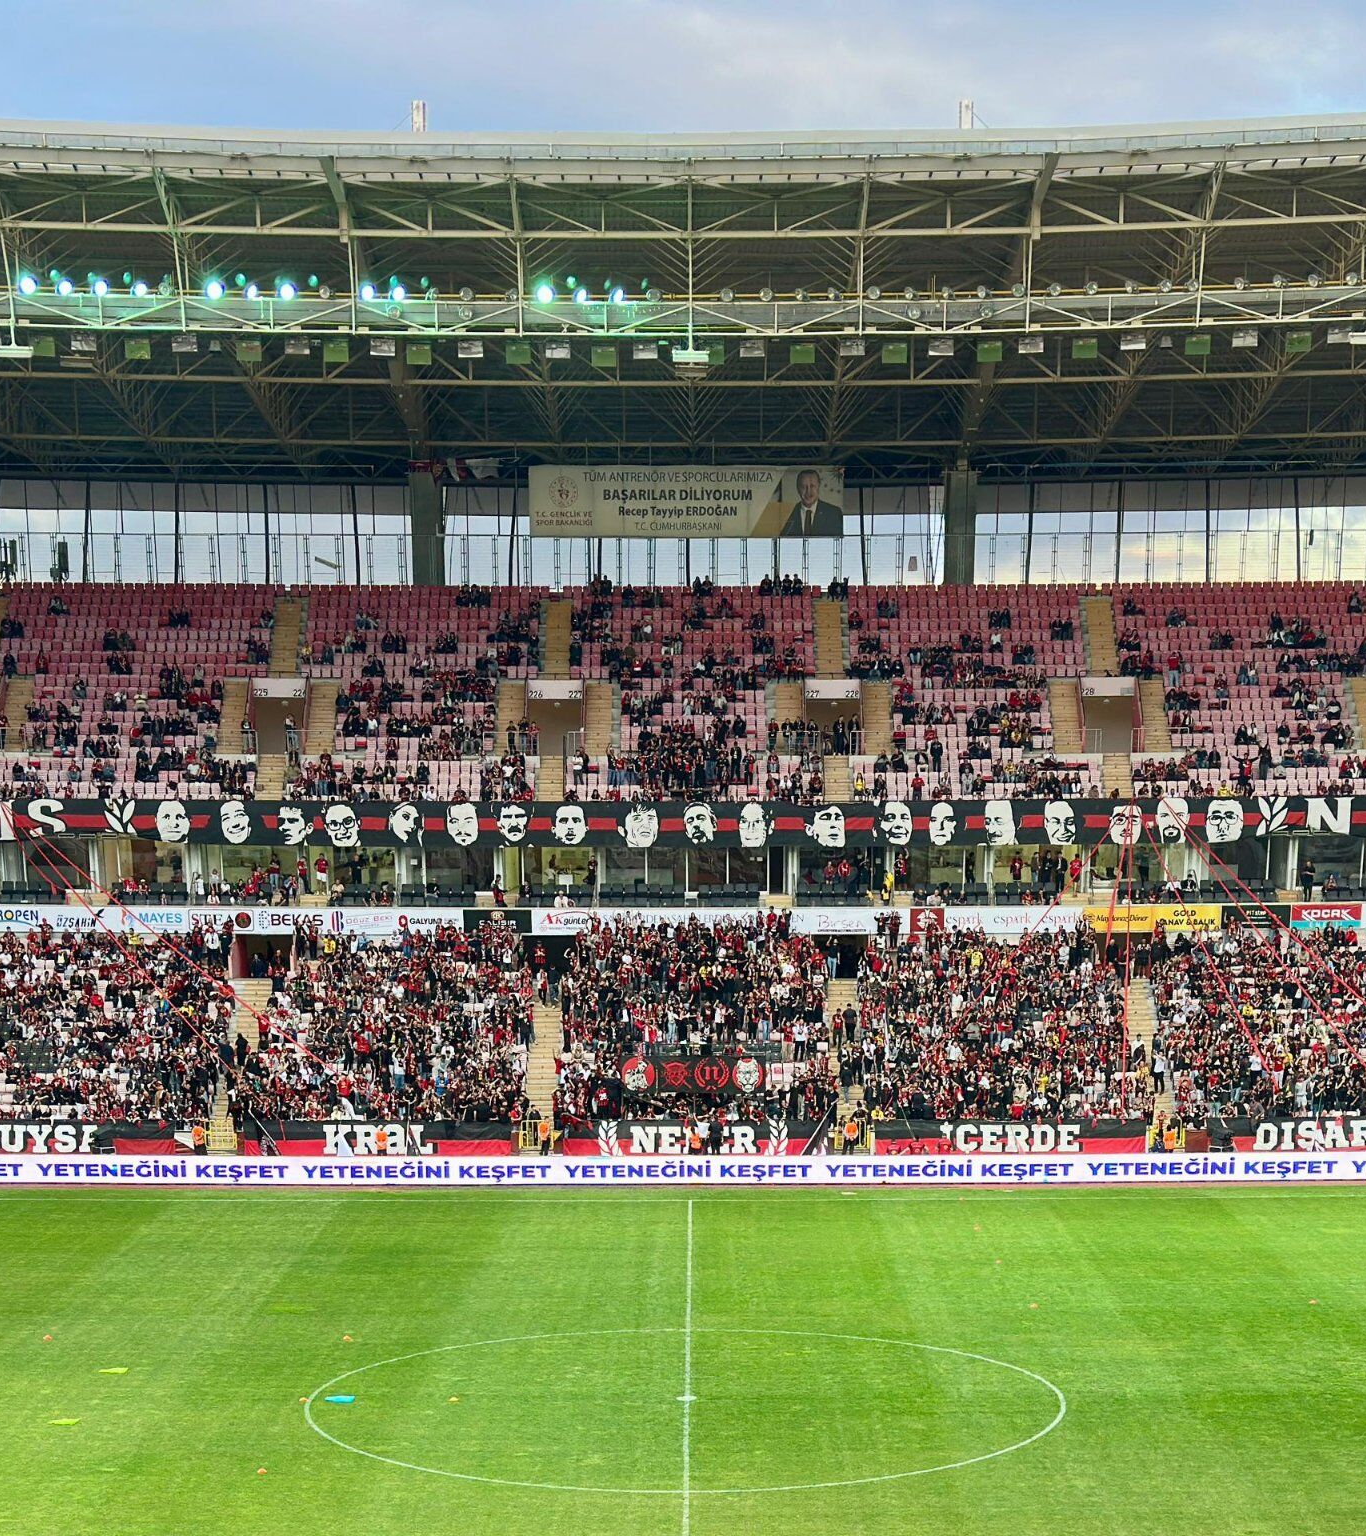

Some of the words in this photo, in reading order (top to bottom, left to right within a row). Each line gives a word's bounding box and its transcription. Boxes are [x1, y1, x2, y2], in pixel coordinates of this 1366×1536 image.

[584, 470, 607, 482] TÜM
[609, 470, 667, 482] ANTRENÖR
[668, 472, 680, 482] VE
[681, 472, 773, 483] SPORCULARIMIZA
[603, 489, 676, 502] BAŞARILAR
[679, 487, 753, 501] DİLİYORUM
[618, 506, 647, 519] Recep
[650, 505, 683, 519] Tayyip
[686, 504, 738, 517] ERDOĞAN
[650, 522, 722, 533] CUMHURBAŞKANI
[139, 912, 183, 924] MAYES
[1174, 910, 1197, 918] GOLD
[1193, 918, 1216, 926] BALIK
[37, 1160, 187, 1179] YETENEĞİNİ
[194, 1163, 287, 1182] KEŞFET
[302, 1161, 450, 1180] YETENEĞİNİ
[458, 1164, 551, 1182] KEŞFET
[565, 1159, 711, 1180] YETENEĞİNİ
[718, 1163, 811, 1181] KEŞFET
[827, 1160, 973, 1179] YETENEĞİNİ
[980, 1162, 1073, 1181] KEŞFET
[1088, 1158, 1236, 1177] YETENEĞİNİ
[1243, 1160, 1337, 1179] KEŞFET
